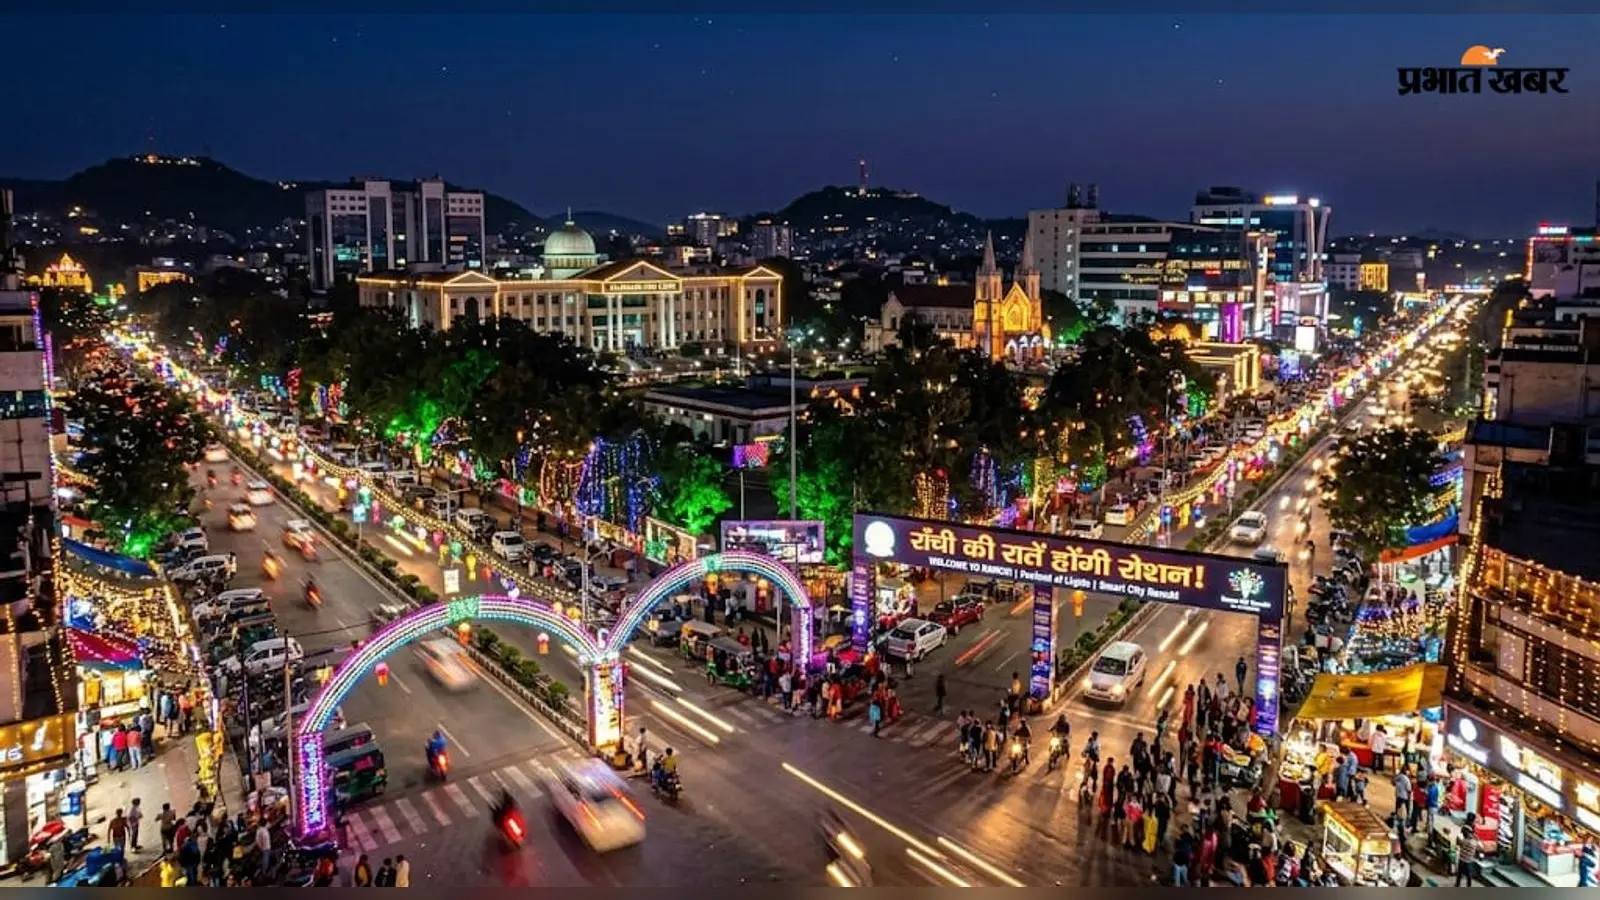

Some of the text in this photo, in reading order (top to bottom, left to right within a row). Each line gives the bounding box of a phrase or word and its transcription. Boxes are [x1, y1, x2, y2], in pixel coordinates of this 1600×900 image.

[928, 556, 968, 570] WELCOME
[962, 533, 996, 561] की
[1000, 540, 1047, 567] रातें
[1050, 544, 1112, 577] होंगी
